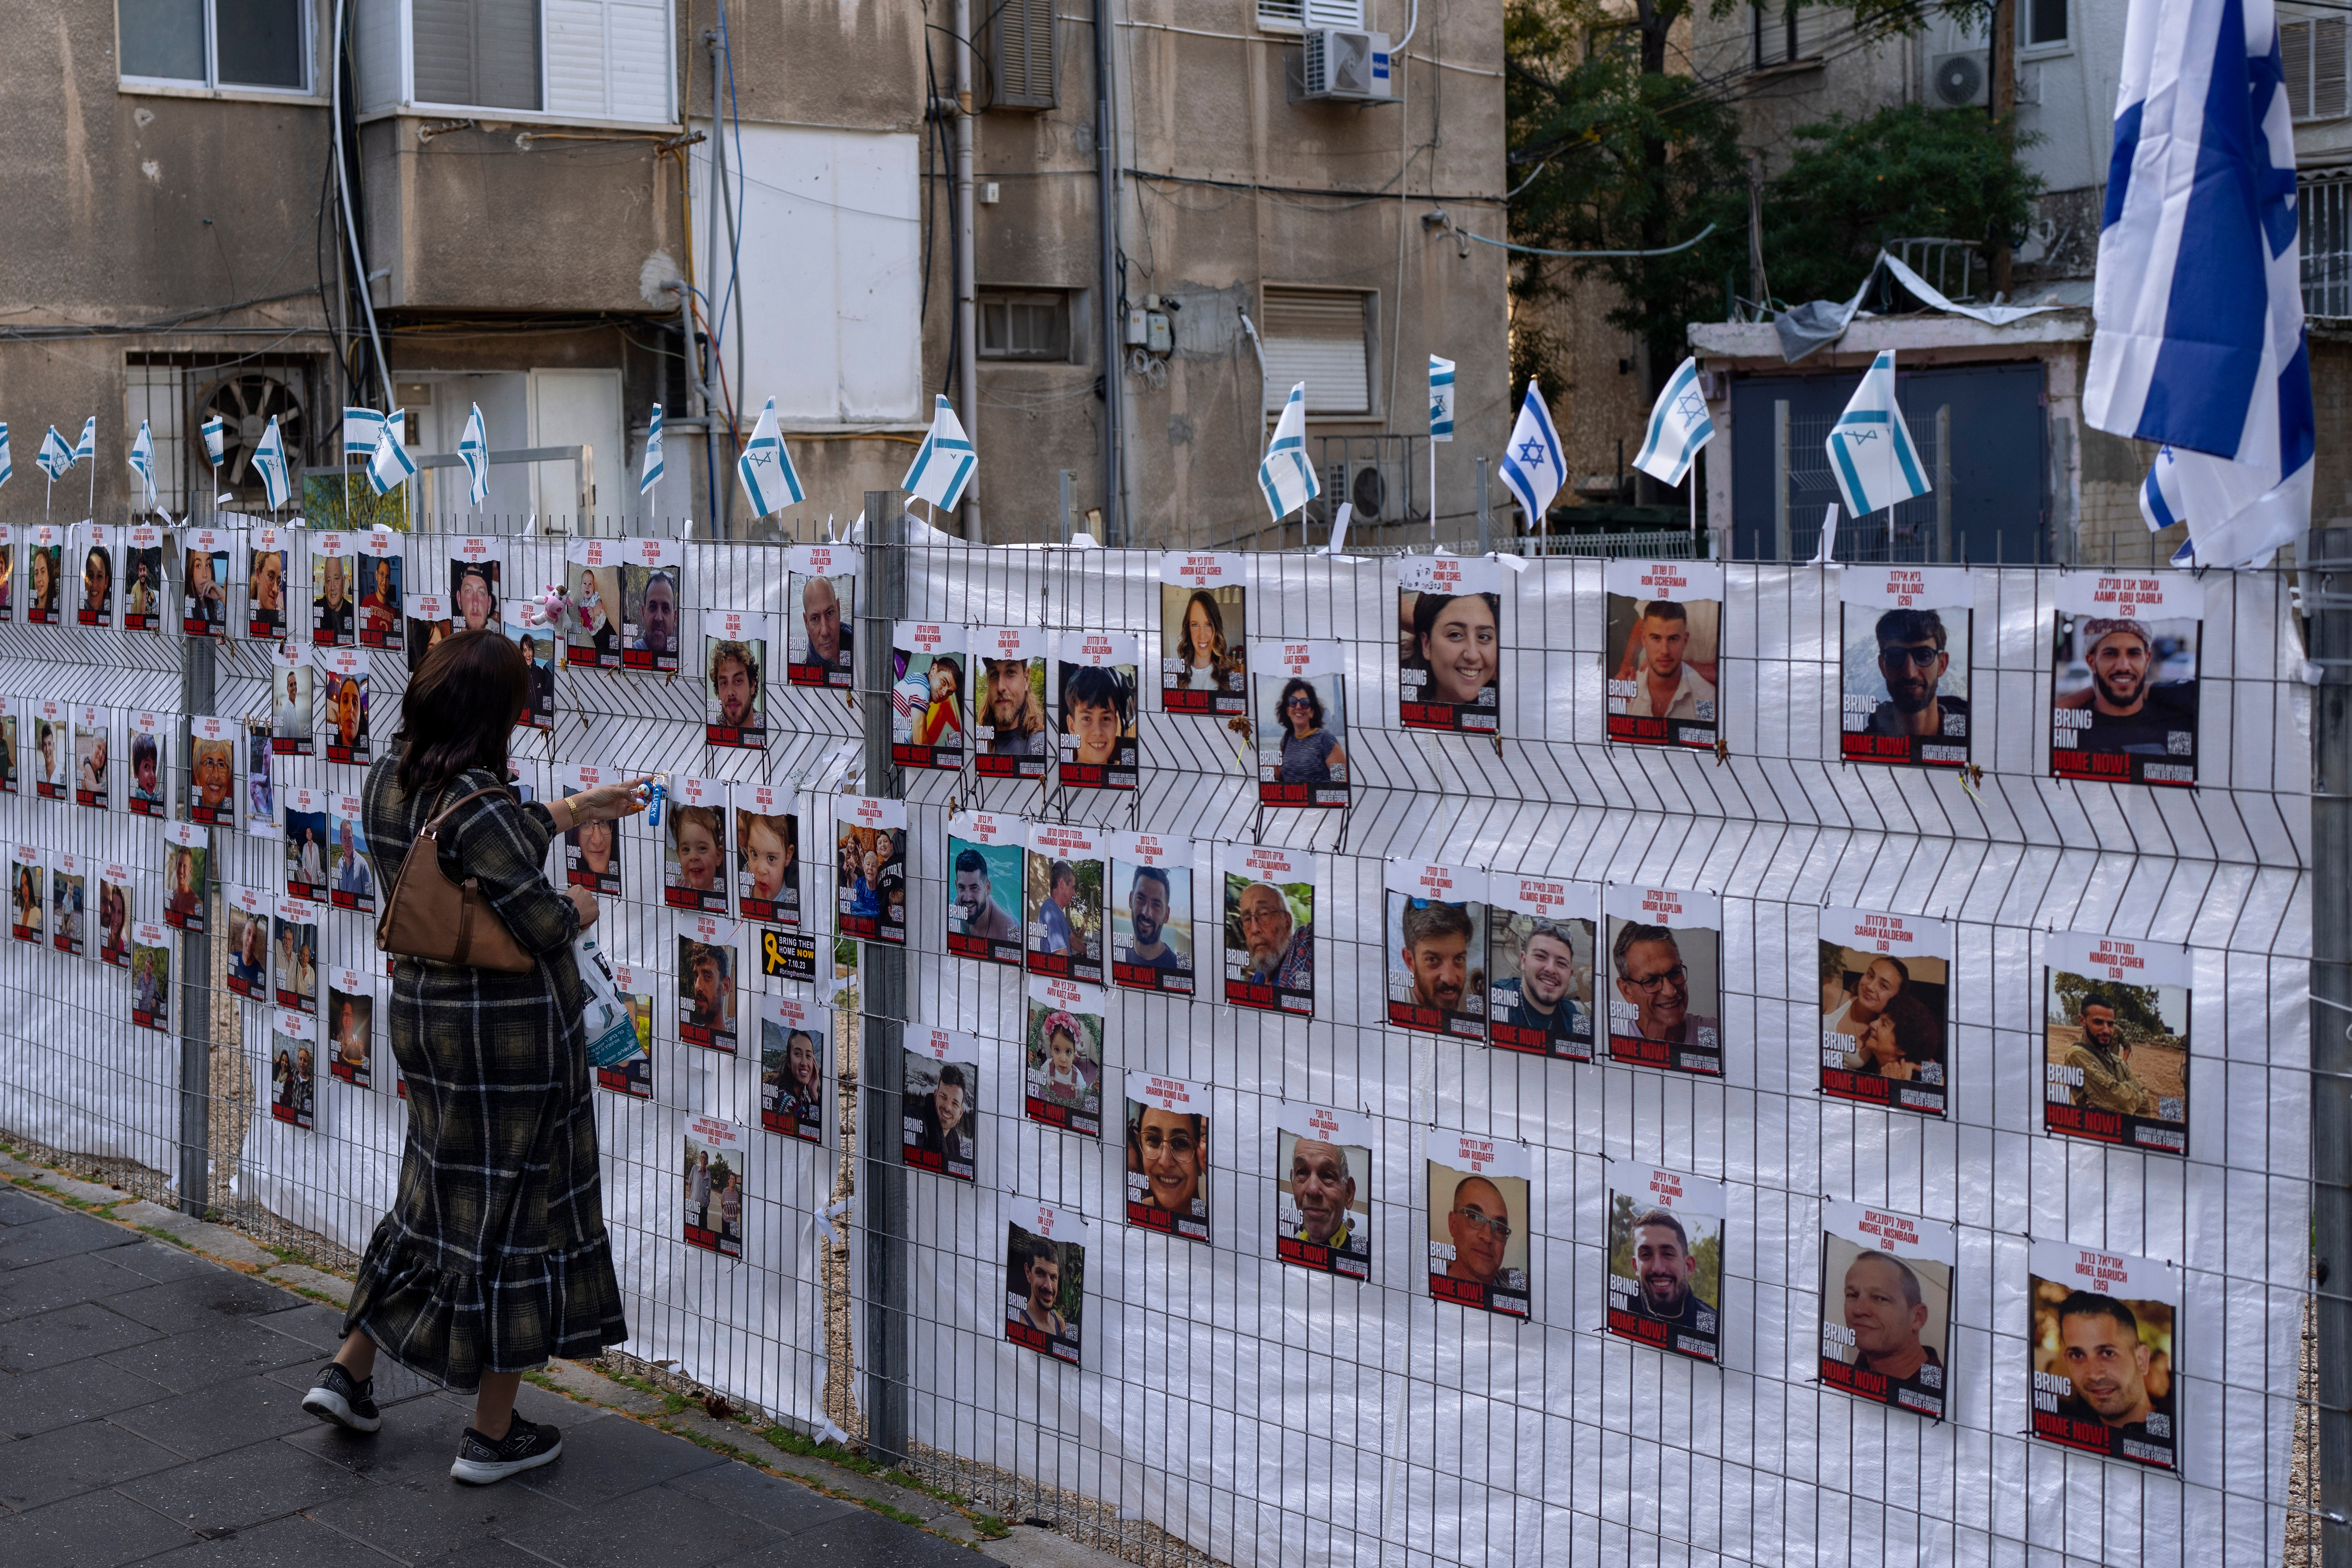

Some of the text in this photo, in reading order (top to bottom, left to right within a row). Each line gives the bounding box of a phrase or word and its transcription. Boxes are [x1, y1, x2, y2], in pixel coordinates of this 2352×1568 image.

[1641, 576, 1687, 587] RON SCHERMAN
[1658, 588, 1669, 598] (19)
[1887, 583, 1924, 594] GUY ILLOUZ
[1898, 595, 1912, 606] (26)
[2094, 591, 2163, 604] AAMR ABU SABILH
[2120, 604, 2135, 616] (25)
[915, 634, 928, 642] MAXIM
[1007, 640, 1019, 648] KRIVOI
[1082, 645, 1112, 655] EREZ KALDERON
[893, 717, 912, 730] BRING
[893, 730, 904, 743] HIM
[893, 746, 930, 762] HOME NOW!
[651, 794, 659, 818] LUCKY
[857, 808, 882, 818] CHANA KATZIR
[980, 824, 996, 834] BERMAN
[887, 862, 903, 879] YORK
[1642, 900, 1682, 913] DROR KAPLUN
[1657, 913, 1668, 924] (68)
[706, 926, 716, 935] KONIO
[1855, 925, 1913, 942] SAHAR KALDERON
[779, 937, 814, 950] BRING THEM
[1877, 940, 1889, 951] (16)
[779, 946, 814, 959] HOME NOW
[788, 959, 805, 969] 7.10.23
[2089, 952, 2144, 968] NIMROD COHEN
[779, 968, 814, 980] #bringthemhome
[2109, 967, 2123, 979] (19)
[787, 1010, 804, 1020] ARGAMANI
[1309, 1118, 1339, 1132] GAD HAGGAI
[692, 1124, 708, 1134] YOCHEVED
[715, 1129, 723, 1138] ODED
[723, 1132, 736, 1141] LIFSHITZ
[1319, 1130, 1329, 1140] (73)
[1459, 1149, 1494, 1162] LIOR RUDAEFF
[1471, 1161, 1481, 1172] (61)
[1650, 1181, 1683, 1197] ORI DANINO
[1659, 1194, 1671, 1206] (24)
[1038, 1215, 1054, 1227] OR LEVY
[1859, 1221, 1918, 1244] MISHEL NISNBAOM
[1881, 1238, 1894, 1251] (59)
[2075, 1263, 2127, 1283] URIEL BARUCH
[2093, 1279, 2108, 1292] (35)
[1824, 1321, 1855, 1346] BRING
[1823, 1339, 1843, 1361] HIM
[1822, 1360, 1887, 1395] HOME NOW!
[1899, 1395, 1941, 1413] FAMILIES FORUM
